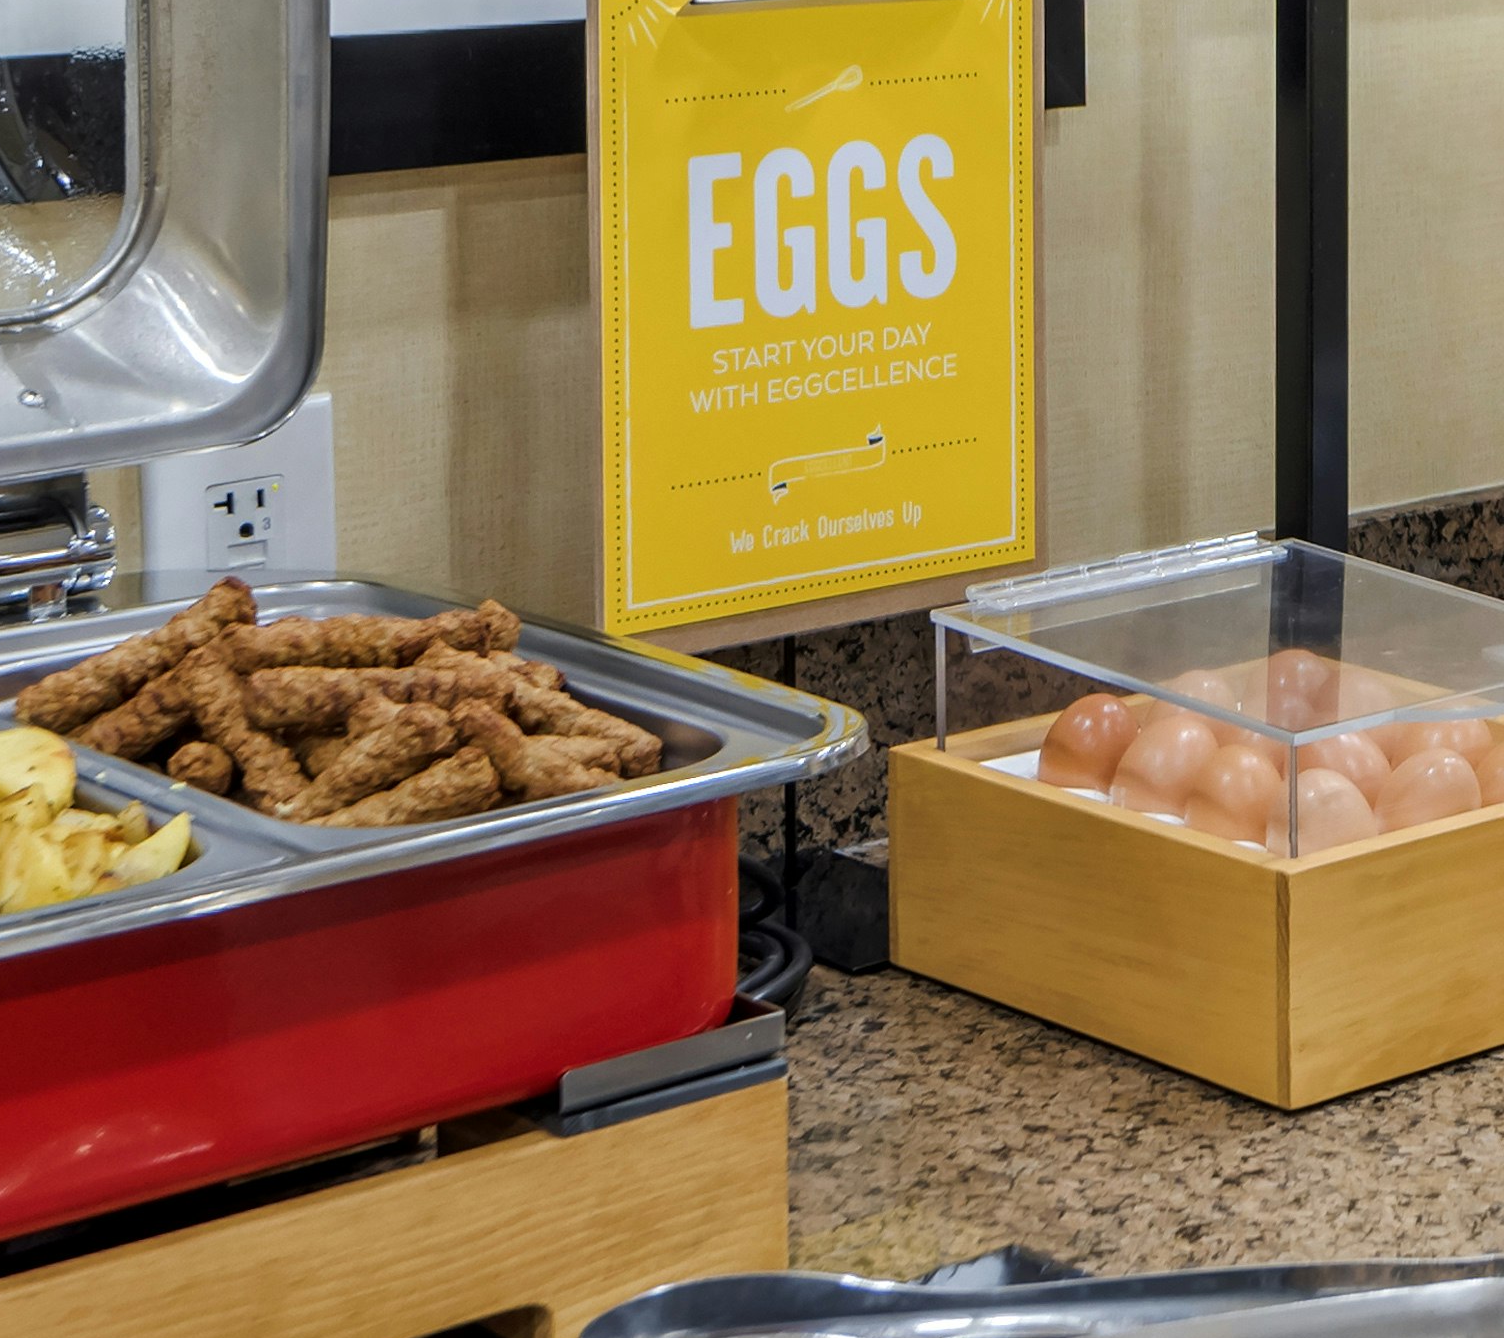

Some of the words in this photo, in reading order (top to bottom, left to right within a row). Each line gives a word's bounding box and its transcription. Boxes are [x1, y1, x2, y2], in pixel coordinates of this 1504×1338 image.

[687, 133, 958, 329] EGGS
[712, 340, 796, 375] START
[801, 330, 875, 361] YOUR
[882, 321, 932, 351] DAY
[690, 381, 759, 413] WITH
[767, 353, 958, 403] EGGCELLENCE
[730, 530, 754, 554] We
[762, 519, 810, 549] Crack
[817, 508, 895, 540] Ourselves
[902, 501, 922, 529] Up
